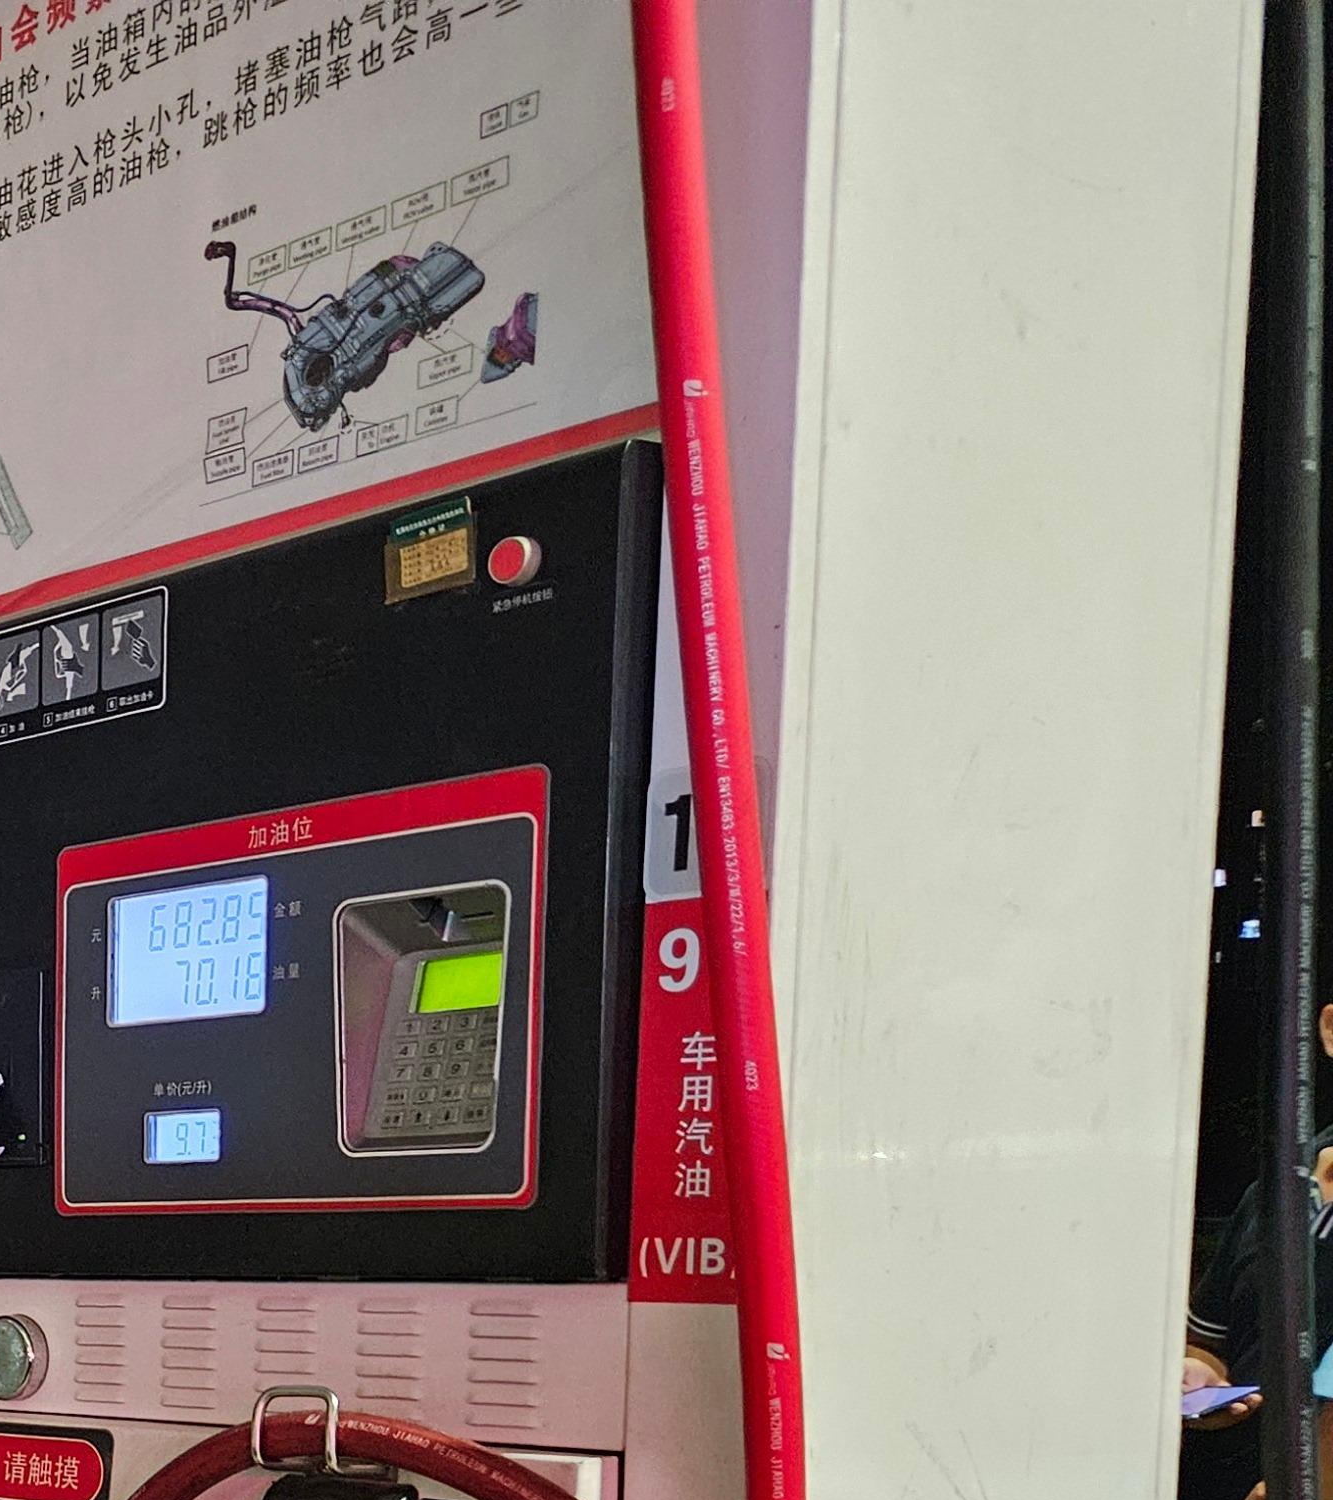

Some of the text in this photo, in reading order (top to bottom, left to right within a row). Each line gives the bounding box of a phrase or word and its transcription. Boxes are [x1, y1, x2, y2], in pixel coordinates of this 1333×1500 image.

[697, 556, 716, 626] PETROLEUM
[703, 630, 726, 703] MACHINERY
[248, 816, 314, 849] 加油位
[274, 901, 301, 919] 金额
[91, 928, 102, 943] 元
[272, 962, 300, 980] 油量
[91, 985, 101, 1001] 升
[153, 1080, 212, 1097] 单价(元/升)
[674, 1030, 718, 1198] 车用汽油
[769, 1397, 783, 1450] WENZHOU
